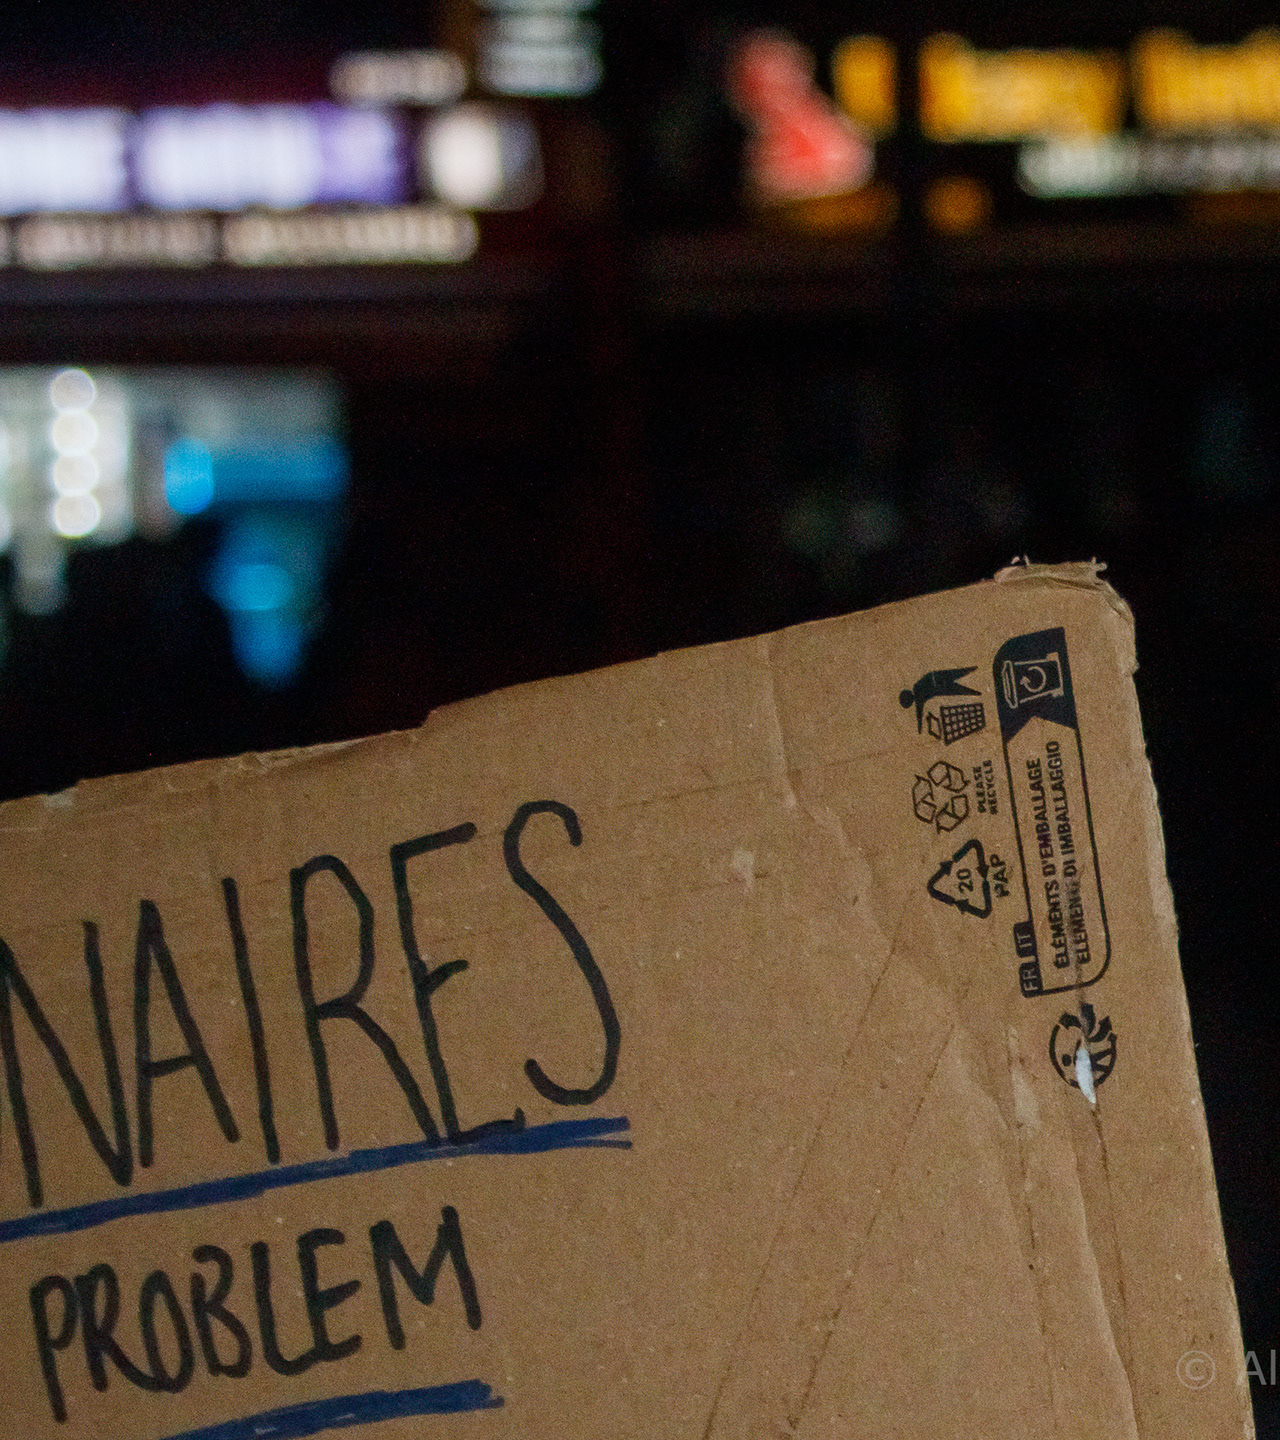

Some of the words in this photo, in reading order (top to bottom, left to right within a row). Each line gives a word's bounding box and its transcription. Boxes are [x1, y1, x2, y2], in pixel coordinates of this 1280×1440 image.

[1046, 740, 1075, 855] IMBALLAGGIO
[956, 868, 974, 893] 20
[990, 854, 1010, 898] PAP
[1063, 859, 1077, 877] DI
[29, 1205, 482, 1423] PROBLEM
